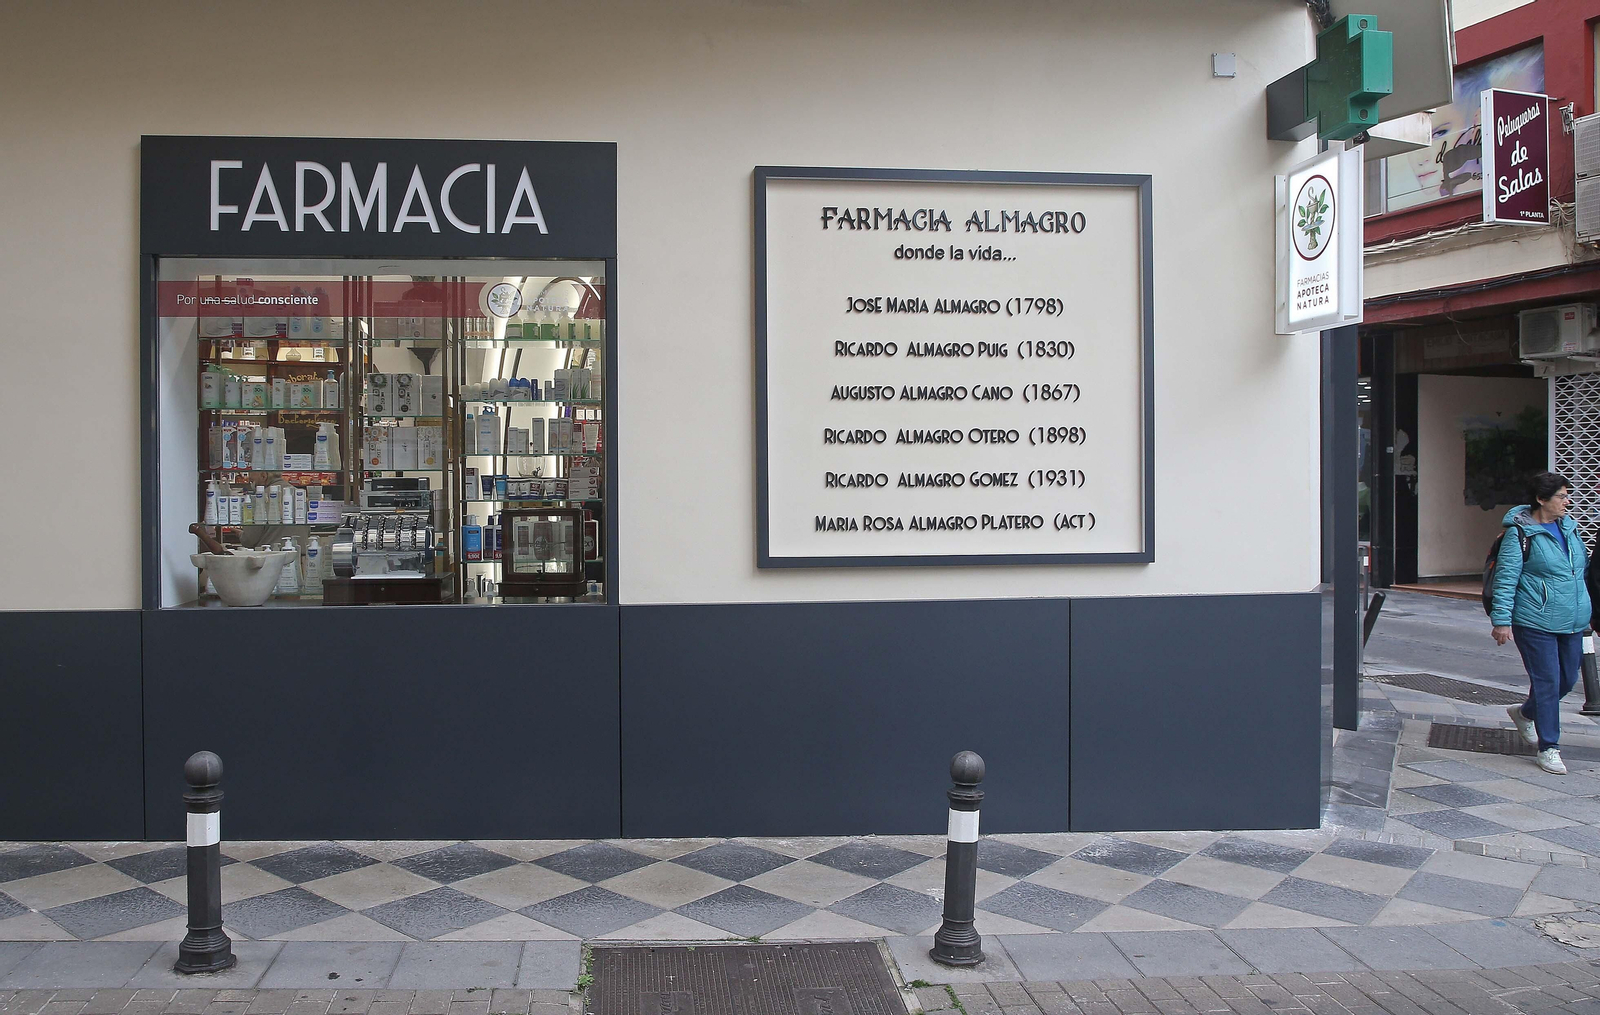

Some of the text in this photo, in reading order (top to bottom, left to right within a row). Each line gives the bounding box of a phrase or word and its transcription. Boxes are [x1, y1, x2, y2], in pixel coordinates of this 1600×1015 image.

[1511, 140, 1528, 167] de
[1498, 167, 1543, 203] Salas
[210, 159, 549, 235] FARMACIA
[820, 206, 1087, 234] FARMACIA ALMAGRO
[893, 243, 1017, 262] donde la vida...
[1297, 271, 1329, 288] FARMACIAS
[176, 294, 319, 305] Por una salud consciente
[1296, 283, 1330, 299] APOTECA
[845, 296, 883, 314] JOSE
[933, 298, 1001, 315] ALMAGRO
[1005, 297, 1064, 317] (1798)
[1296, 295, 1330, 311] NATURA
[834, 340, 1075, 360] RICARDO ALMAGRO PUIG (1830)
[830, 383, 1081, 404] AUGUSTO ALMAGRO CANO (1867)
[824, 426, 1087, 446] RICARDO ALMAGRO OTERO (1898)
[825, 469, 1086, 489] RICARDO ALMAGRO GOMEZ (1931)
[815, 512, 1096, 532] MARIA ROSA ALMAGRO PLATERO (ACT)
